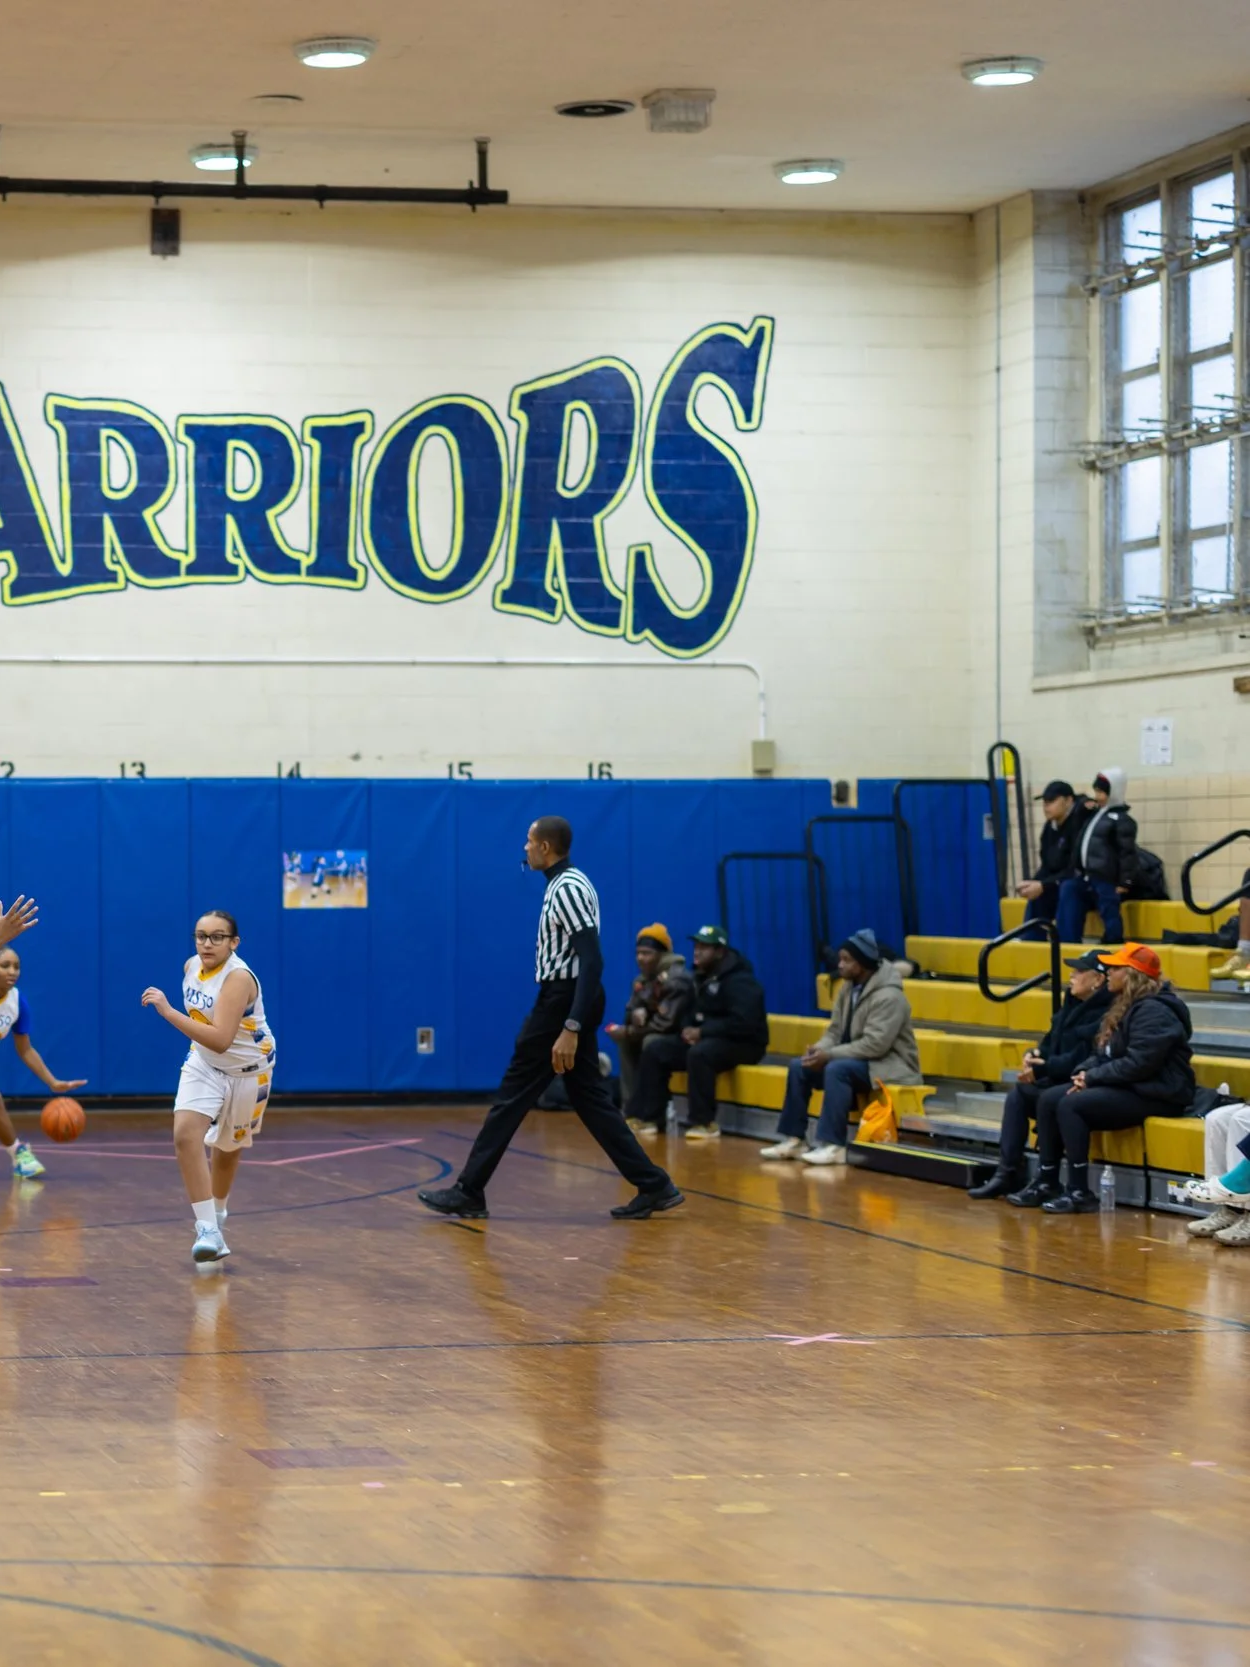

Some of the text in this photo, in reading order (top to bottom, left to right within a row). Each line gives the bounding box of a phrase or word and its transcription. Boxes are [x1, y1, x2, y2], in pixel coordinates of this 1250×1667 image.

[119, 761, 146, 779] 13
[277, 761, 302, 779] 14
[448, 761, 473, 780] 15
[587, 761, 613, 780] 16
